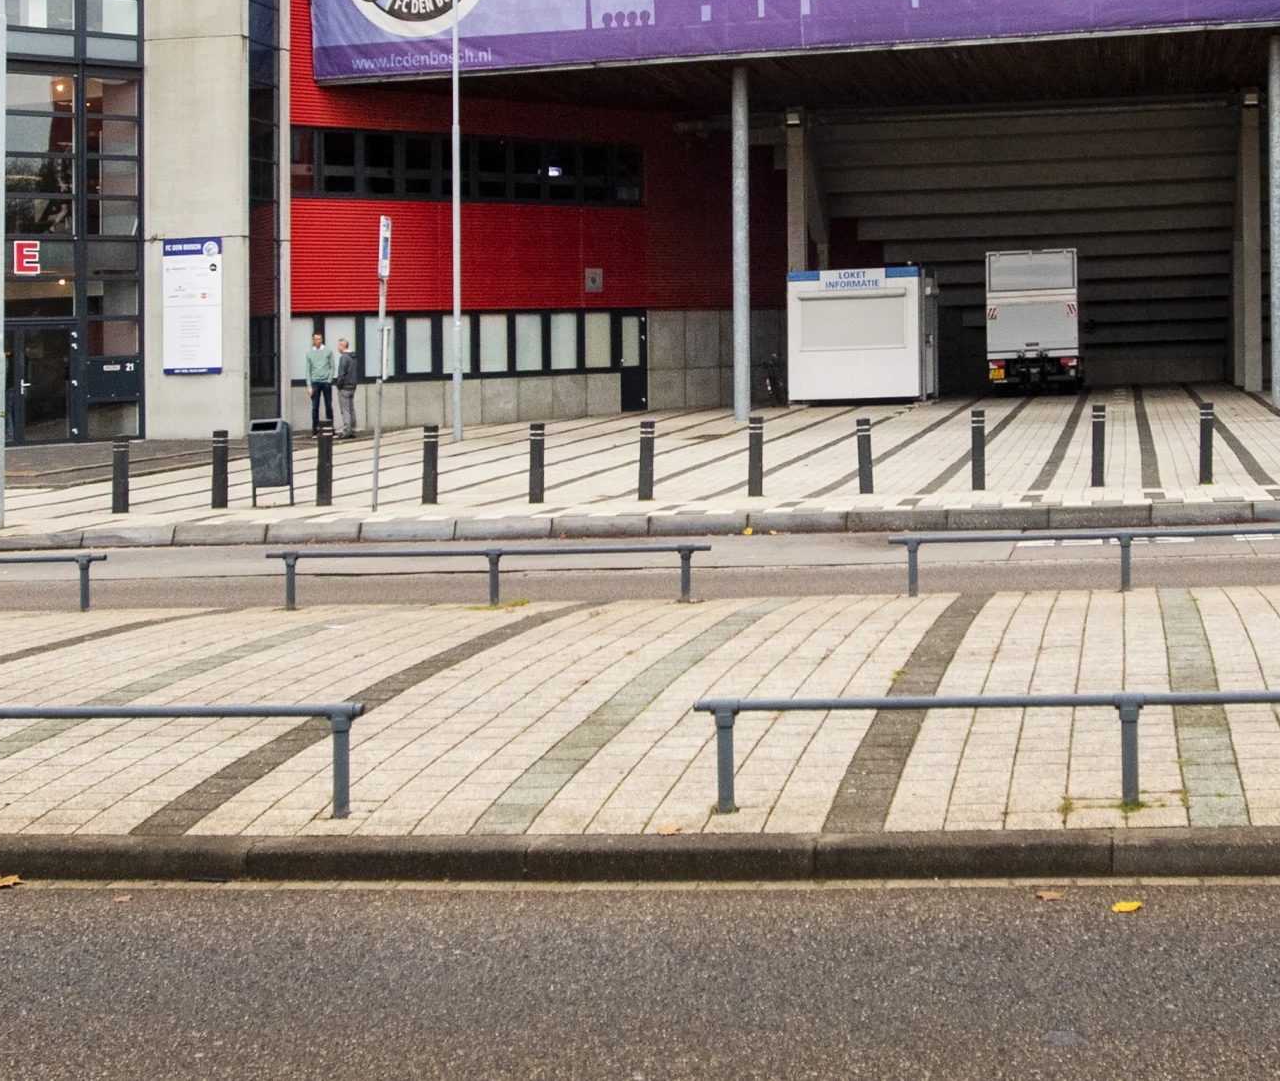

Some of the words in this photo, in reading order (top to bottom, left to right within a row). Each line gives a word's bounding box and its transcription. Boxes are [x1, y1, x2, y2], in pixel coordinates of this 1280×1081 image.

[13, 240, 41, 274] E
[838, 271, 866, 280] LOKET
[825, 279, 880, 289] INFORMATIE
[125, 362, 135, 371] 21
